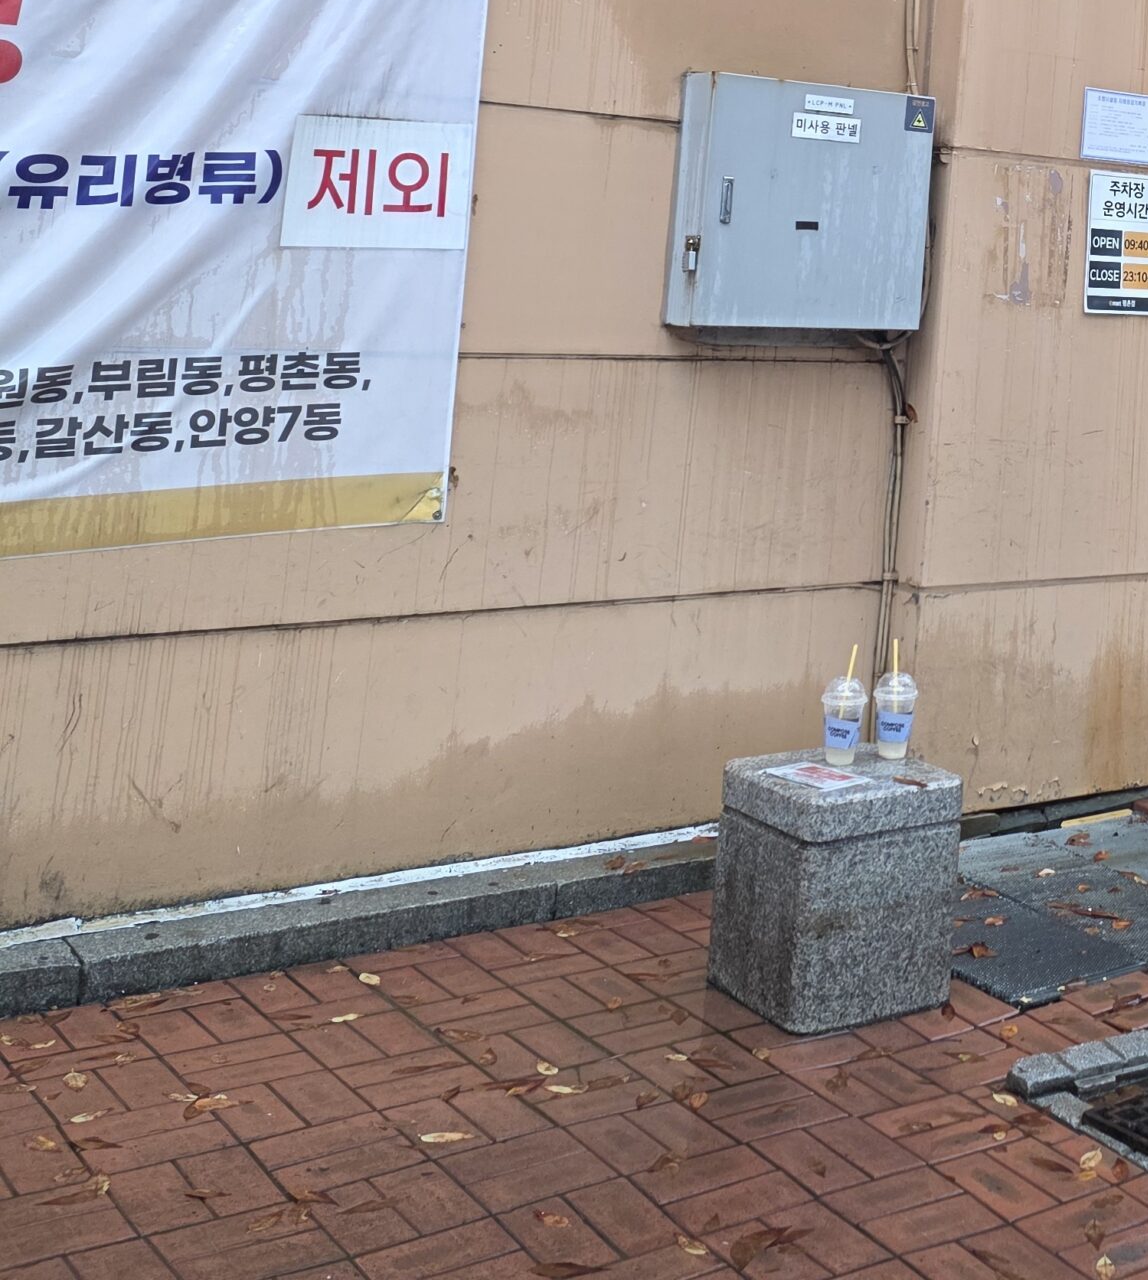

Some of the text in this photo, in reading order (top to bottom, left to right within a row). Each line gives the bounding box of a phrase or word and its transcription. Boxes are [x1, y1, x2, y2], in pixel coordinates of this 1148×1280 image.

[796, 118, 858, 138] 미사용 판넬
[0, 149, 283, 209] 유리병류)
[307, 148, 450, 218] 제외
[1109, 180, 1145, 199] 주차장
[1092, 235, 1120, 250] OPEN
[1089, 268, 1120, 282] CLOSE
